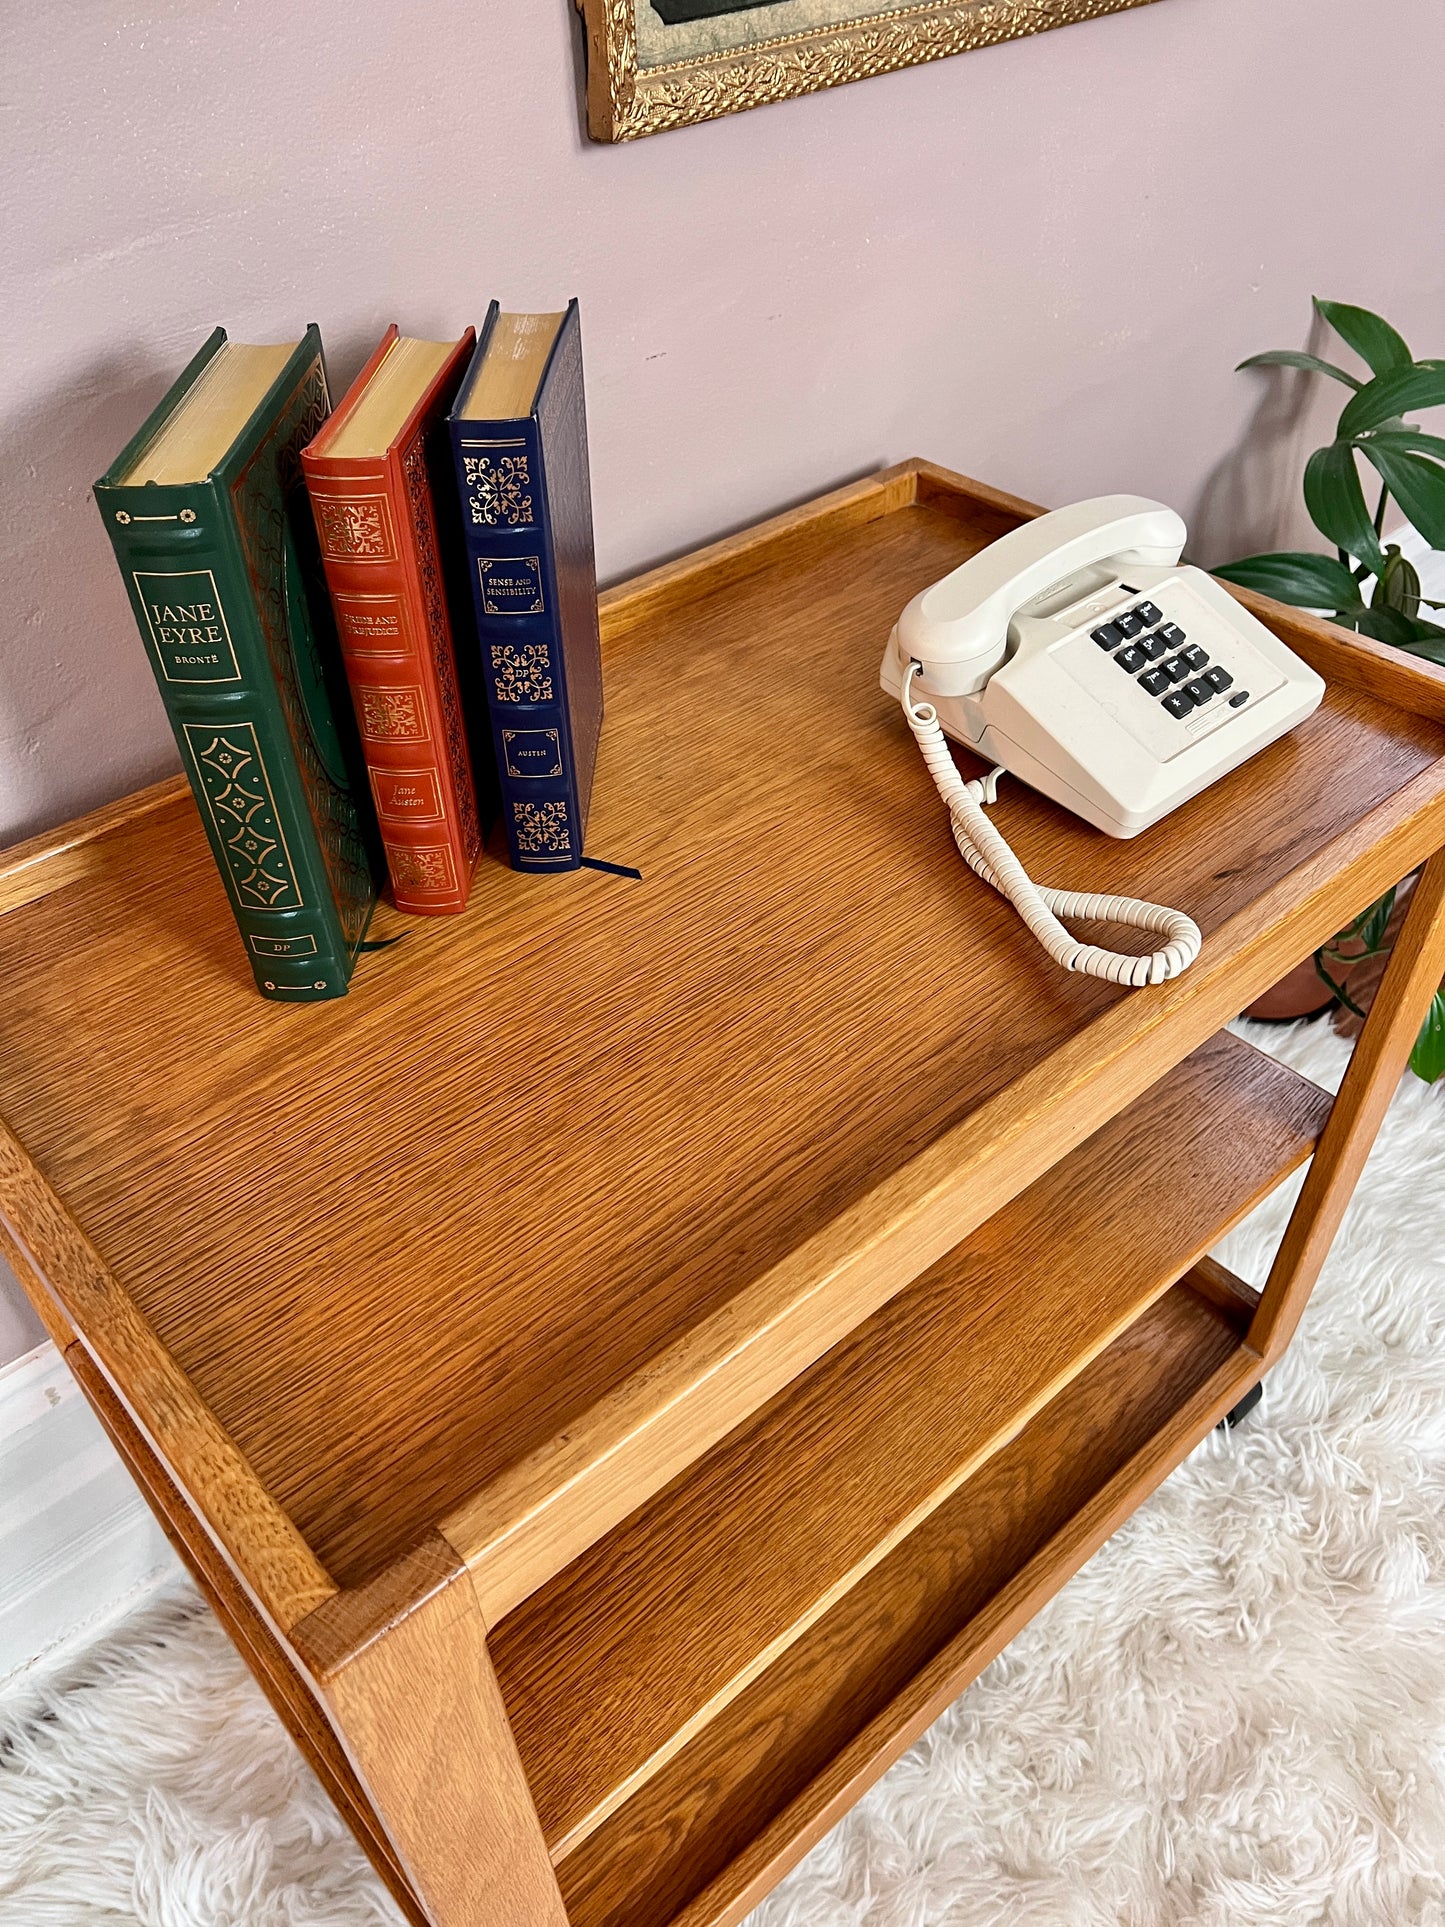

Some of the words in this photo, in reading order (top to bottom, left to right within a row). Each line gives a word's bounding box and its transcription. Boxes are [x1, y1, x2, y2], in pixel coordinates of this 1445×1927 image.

[488, 578, 513, 586] SENSE
[515, 578, 531, 586] AND
[486, 586, 537, 596] SENSIBILITY
[151, 603, 216, 625] JANE
[375, 615, 398, 625] AND
[158, 625, 223, 645] EYRE
[174, 653, 219, 665] BRONTË
[515, 669, 529, 678] DP
[518, 749, 547, 757] AUSTEN
[392, 784, 416, 796] Jane
[388, 796, 425, 807] Austen
[273, 944, 291, 952] DP
